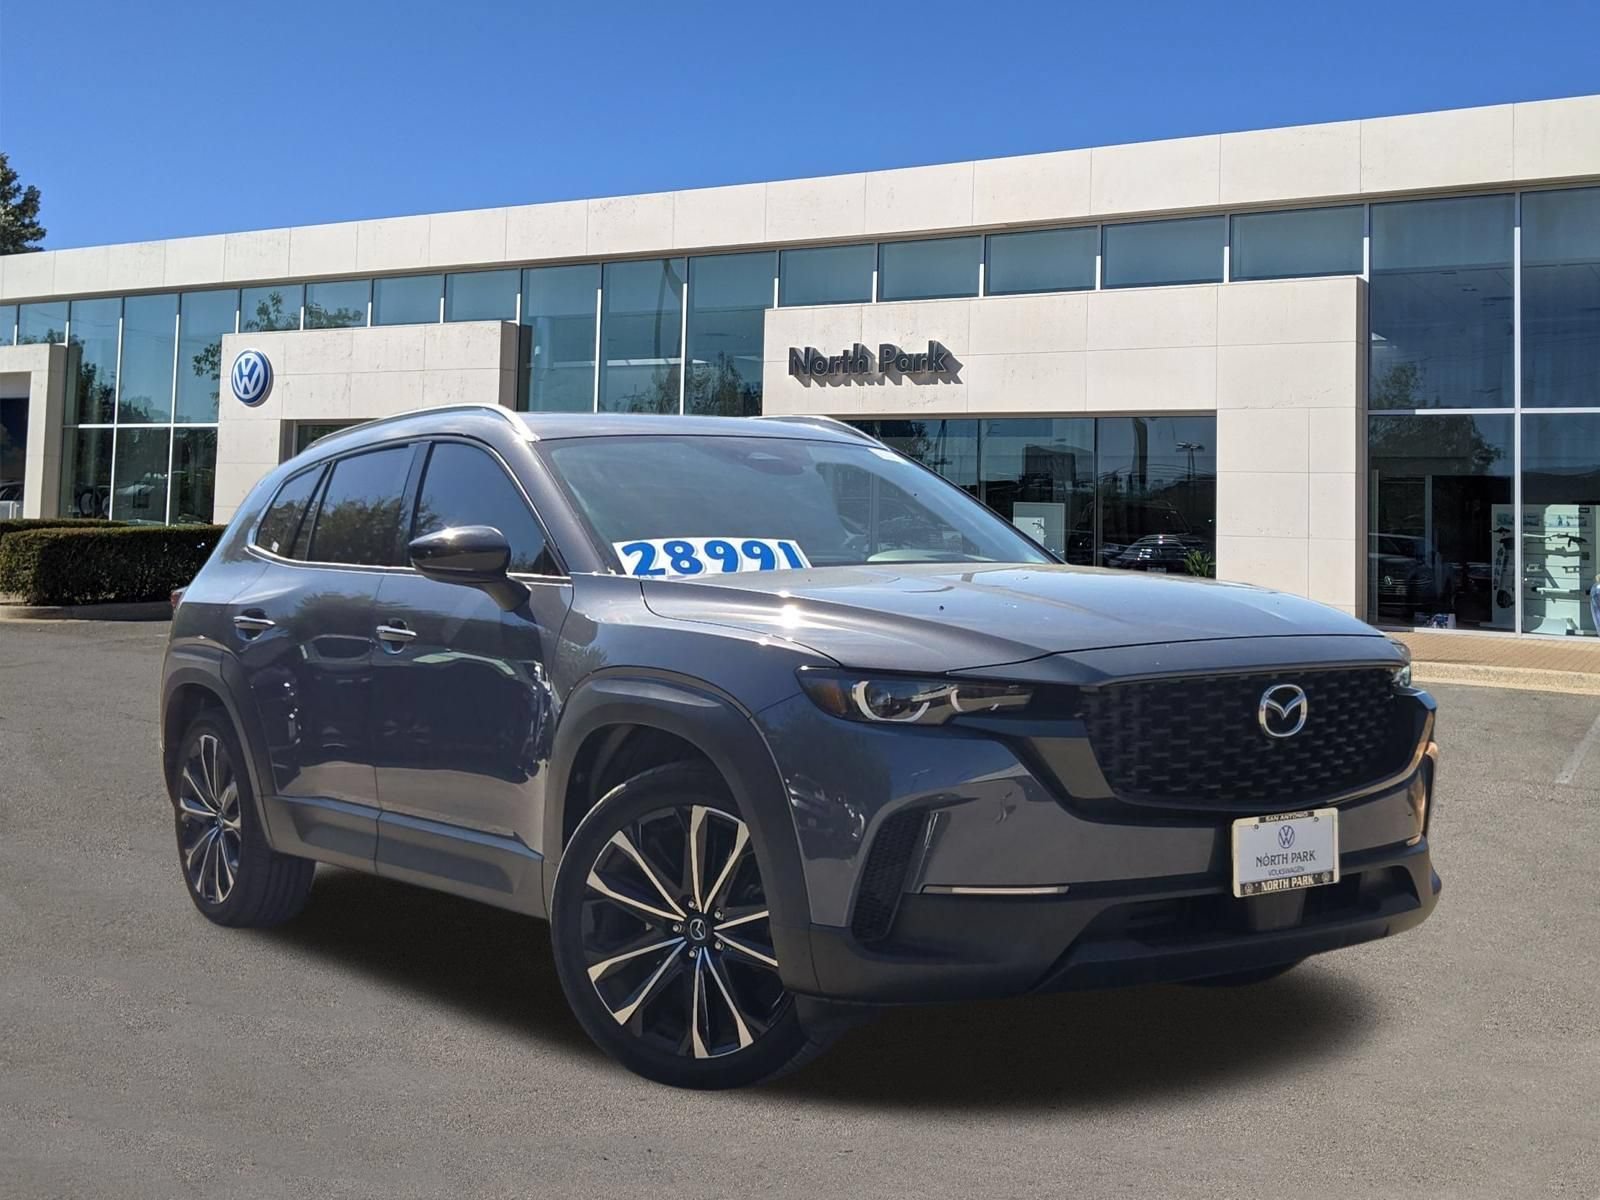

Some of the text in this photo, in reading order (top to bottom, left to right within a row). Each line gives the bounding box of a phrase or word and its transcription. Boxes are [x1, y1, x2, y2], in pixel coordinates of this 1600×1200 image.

[788, 340, 948, 377] North Park
[621, 540, 803, 576] 28991
[1256, 850, 1316, 867] NORTH PARK
[1261, 878, 1289, 891] NORTH
[1291, 875, 1314, 888] PARK
